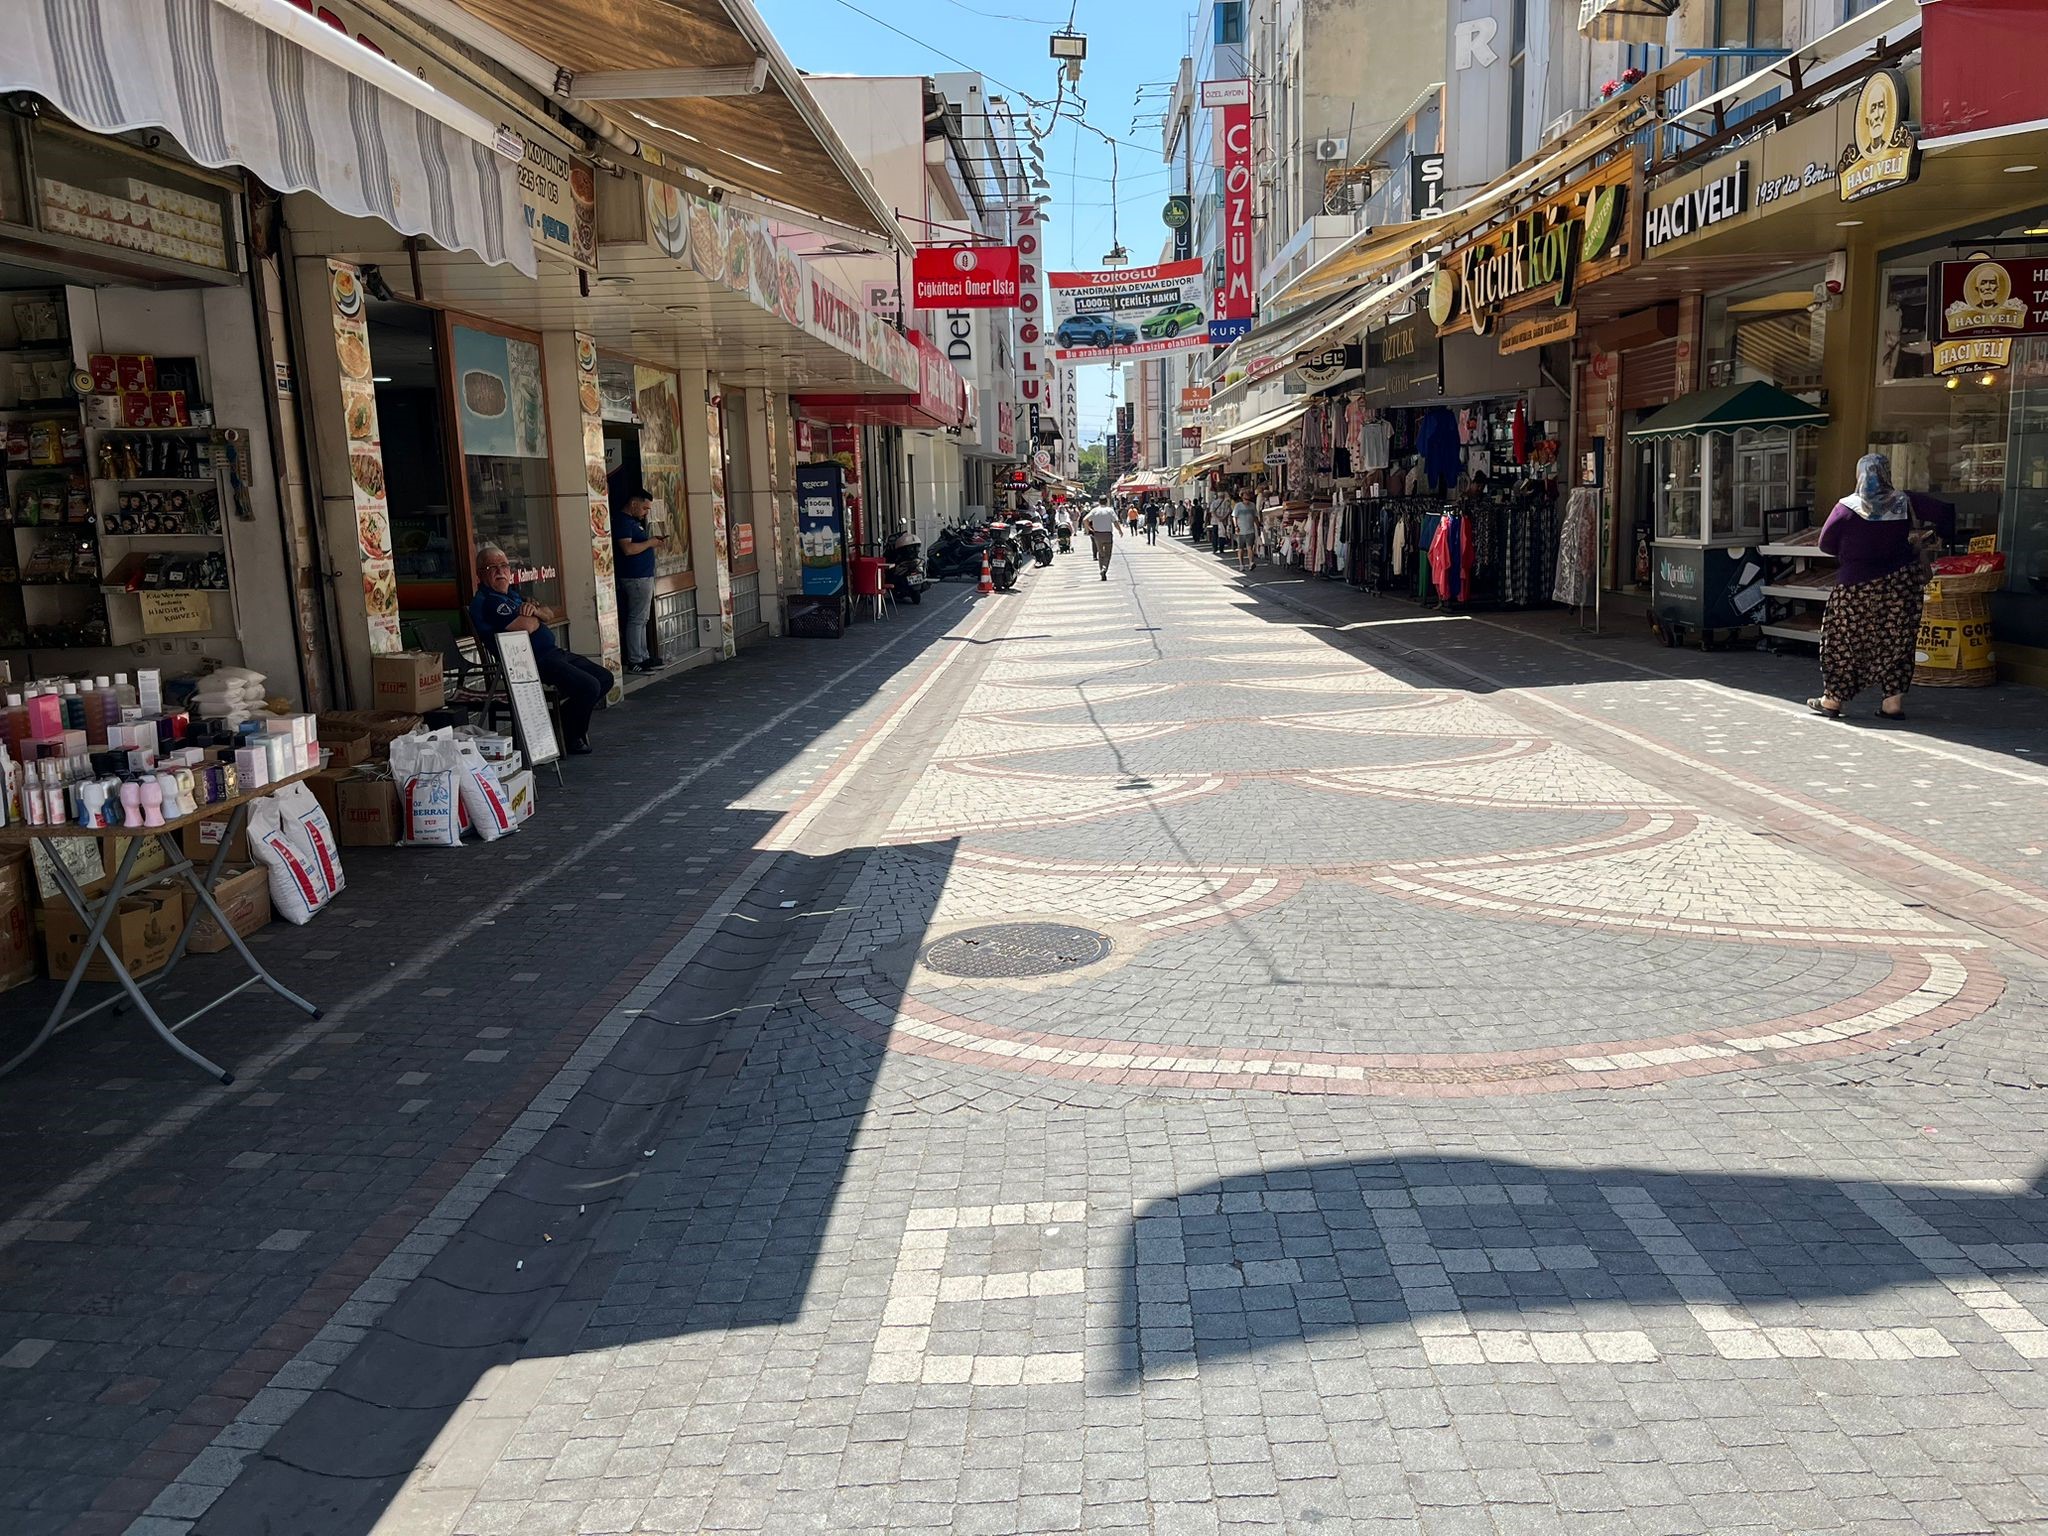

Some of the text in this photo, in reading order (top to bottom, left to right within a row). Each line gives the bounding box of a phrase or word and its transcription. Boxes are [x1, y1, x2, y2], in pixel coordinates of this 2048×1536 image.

[1454, 16, 1499, 71] R
[527, 139, 569, 181] KOYUNCU
[1847, 151, 1903, 190] HACI VELİ
[518, 165, 535, 192] 225
[548, 181, 559, 204] 05
[1755, 174, 1800, 207] 1938'den
[1227, 124, 1250, 299] ÇÖZÜM
[1646, 160, 1742, 248] HACI VELİ
[918, 276, 1015, 299] Çiğköfteci Ömer Usta
[1120, 294, 1151, 310] ÇEKİLİŞ
[1152, 292, 1179, 304] HAKKI
[1128, 281, 1160, 292] DEVAM
[1017, 206, 1039, 400] ZOROĞLU
[1210, 326, 1246, 336] KURS
[1955, 311, 2018, 327] HACI VELİ
[1066, 350, 1077, 359] Bu
[1147, 341, 1166, 352] sizin
[1168, 336, 1201, 349] olabilir!
[1940, 338, 2004, 365] HACI VELİ
[1066, 369, 1077, 463] SARANLAR
[1183, 438, 1200, 447] NOT
[413, 808, 449, 817] BERRAK
